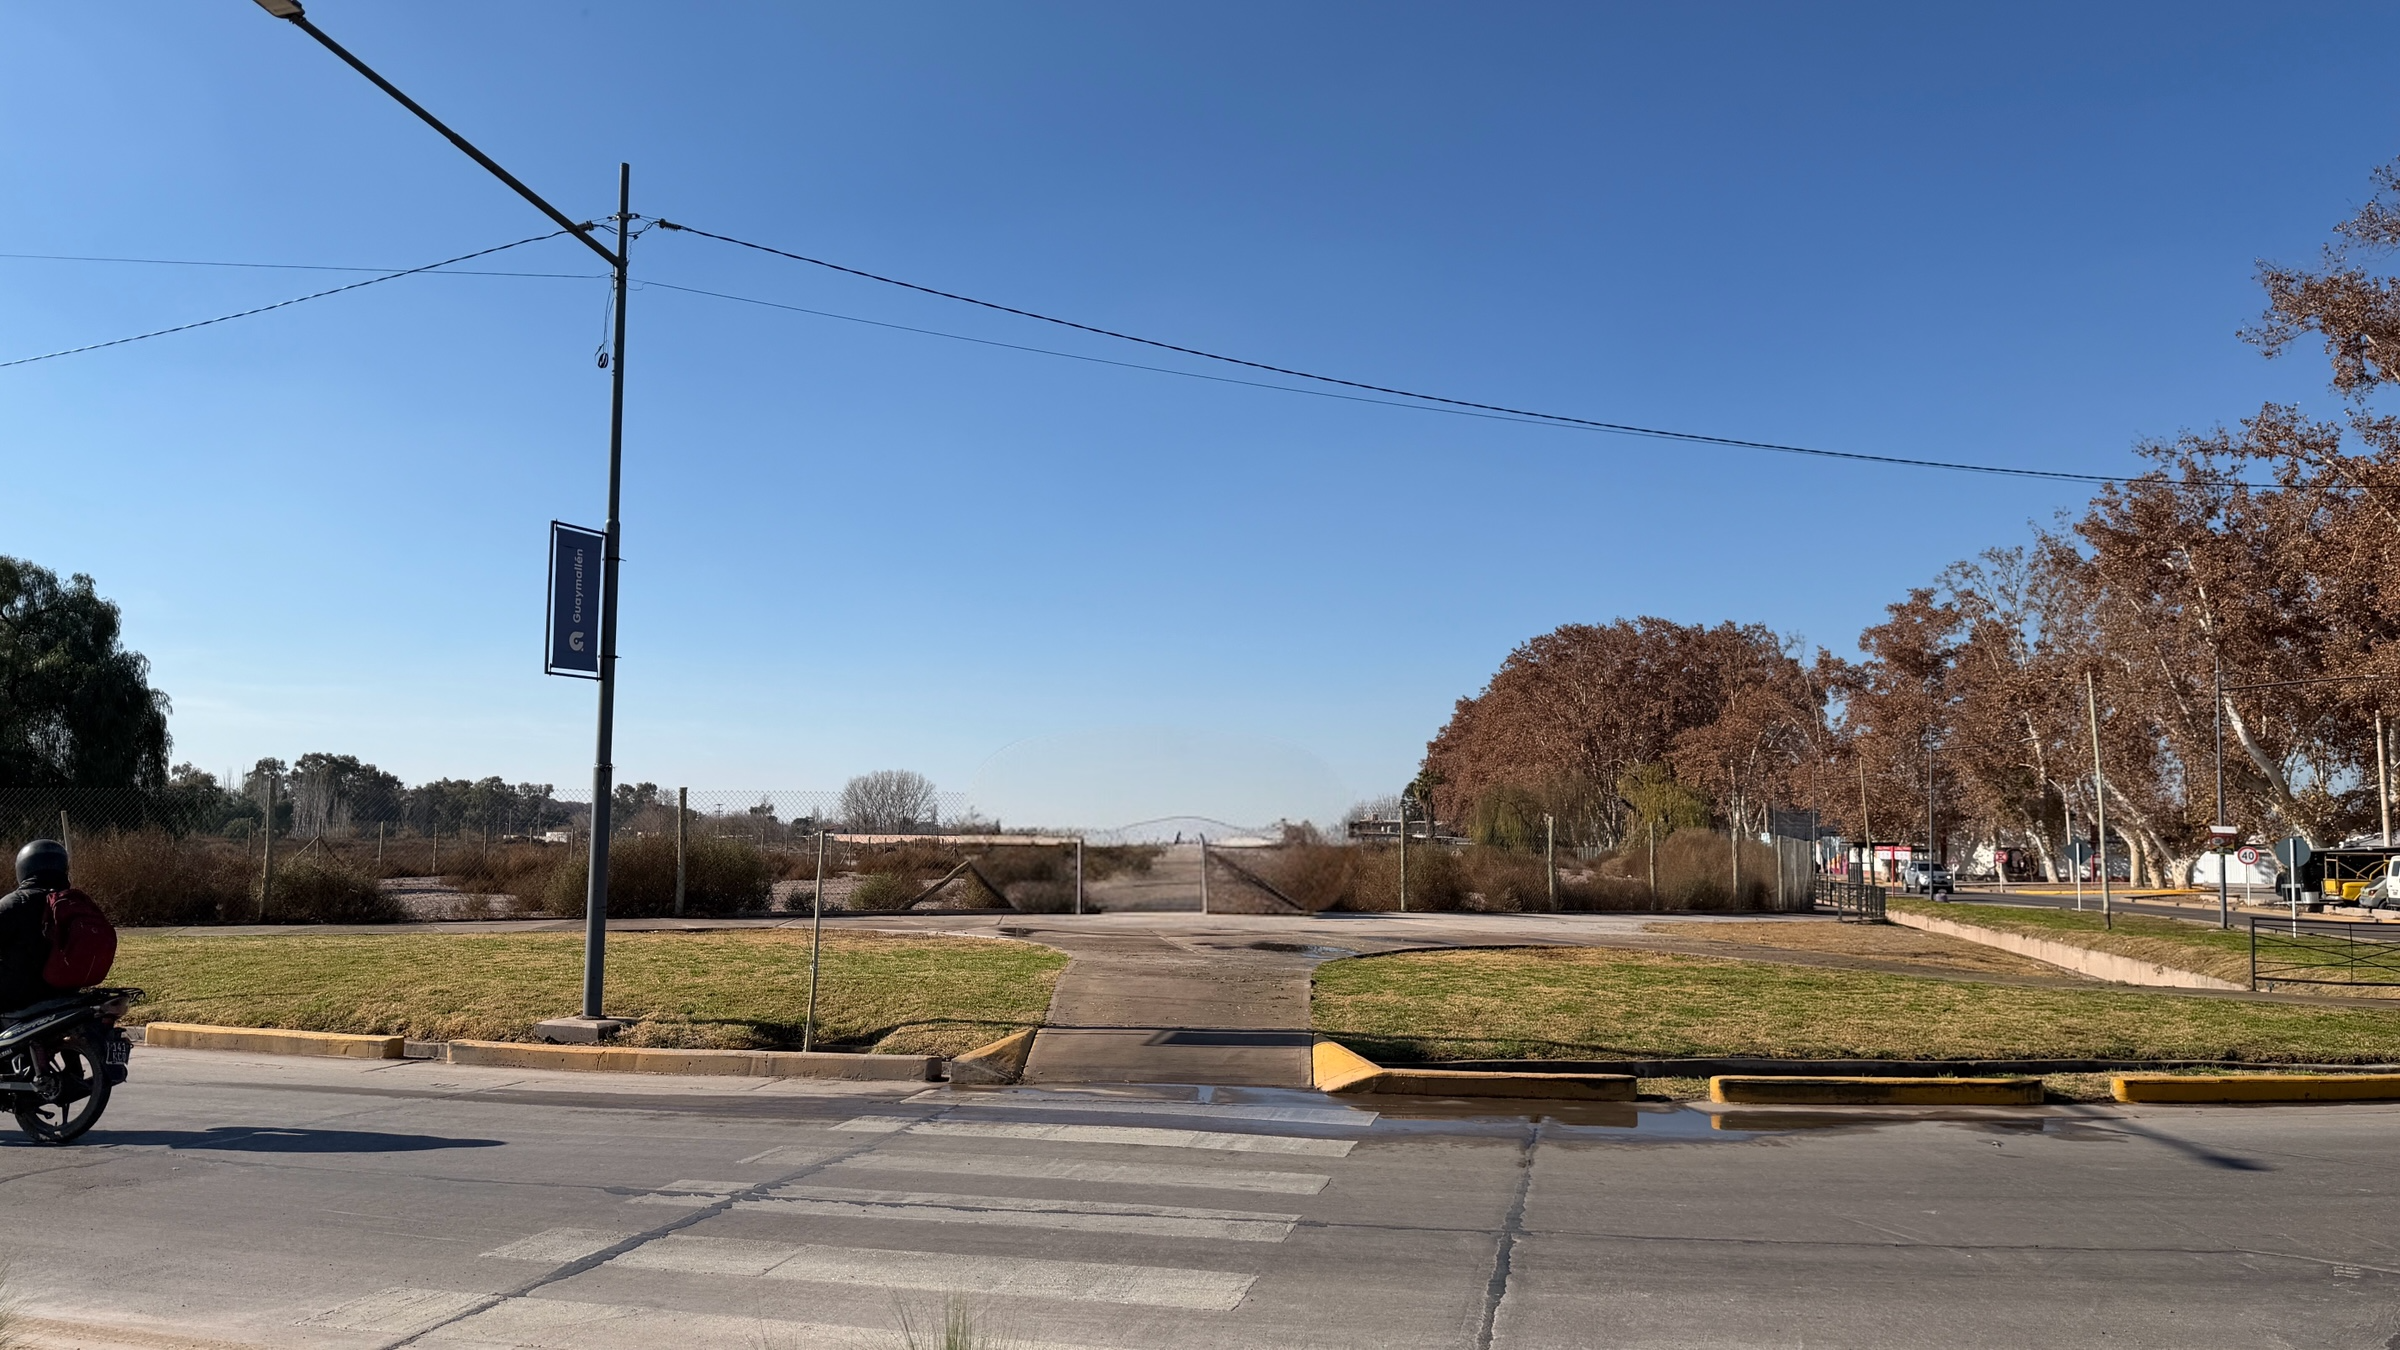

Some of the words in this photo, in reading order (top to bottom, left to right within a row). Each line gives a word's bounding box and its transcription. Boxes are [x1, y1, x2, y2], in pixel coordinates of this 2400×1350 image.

[572, 549, 584, 623] Guaymallén
[2242, 852, 2254, 860] 40
[112, 1042, 126, 1052] 141
